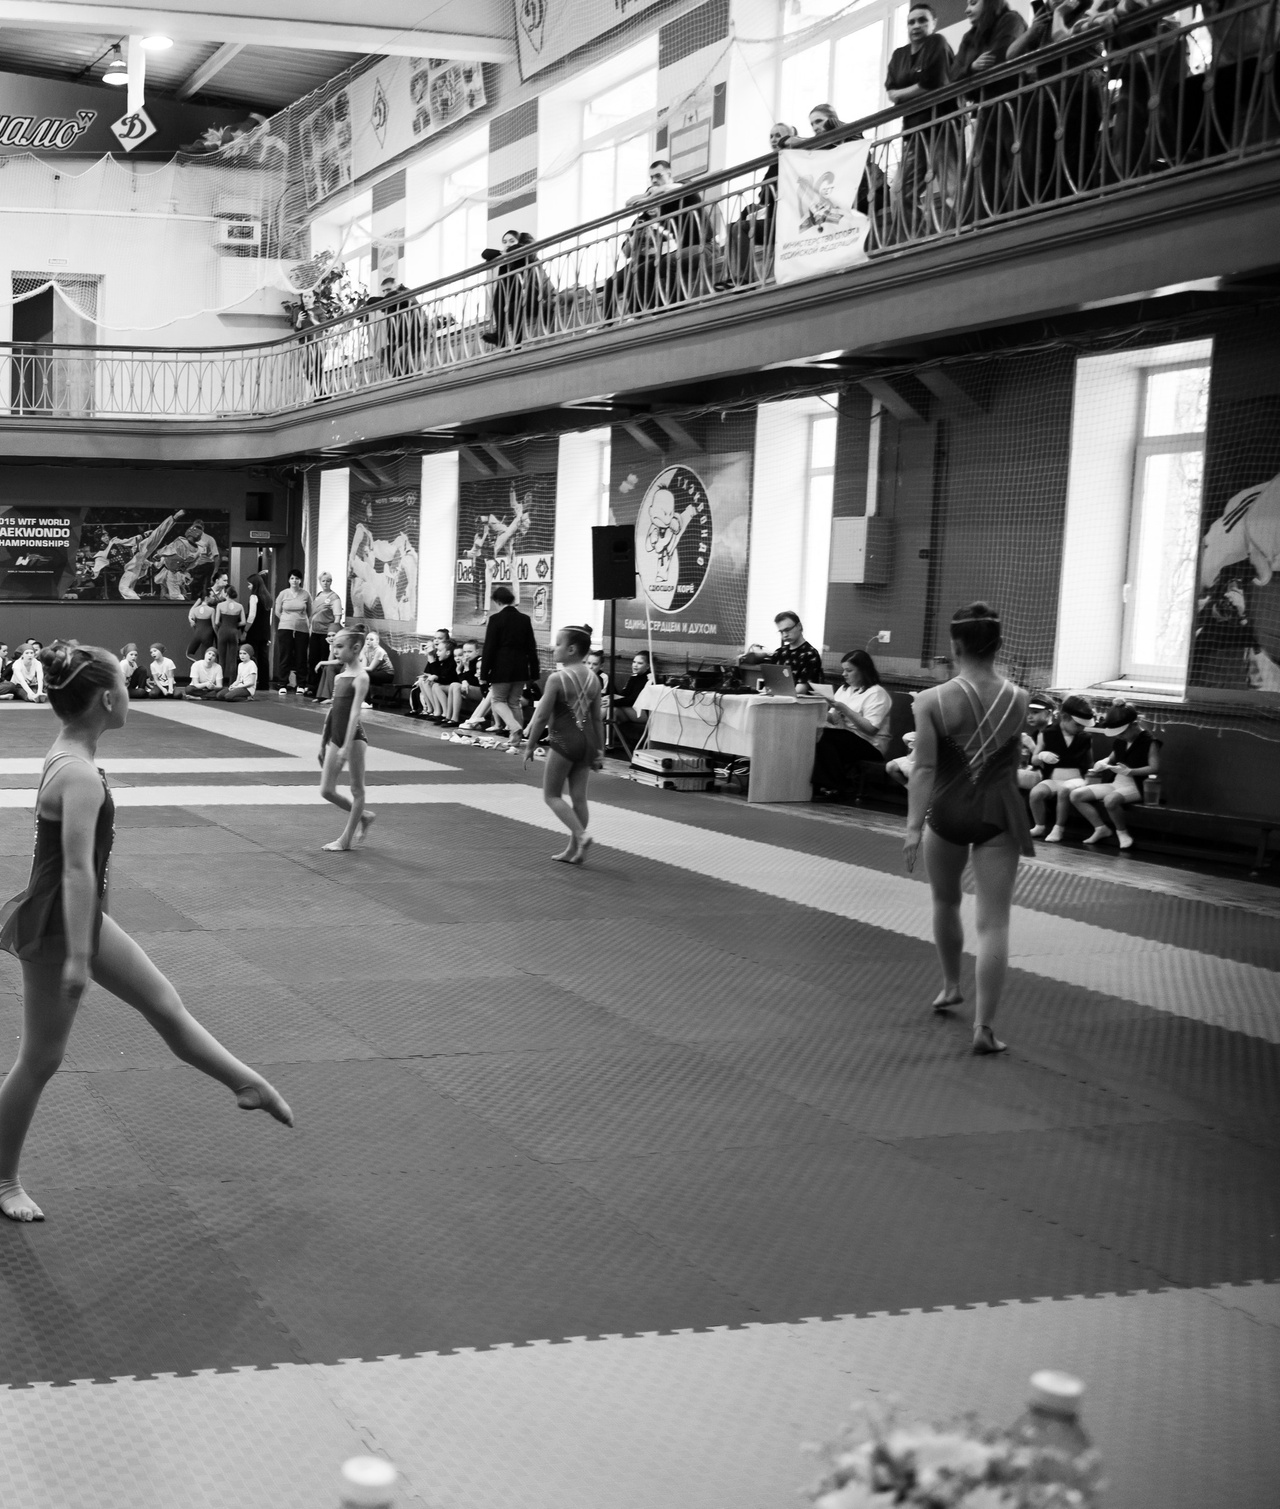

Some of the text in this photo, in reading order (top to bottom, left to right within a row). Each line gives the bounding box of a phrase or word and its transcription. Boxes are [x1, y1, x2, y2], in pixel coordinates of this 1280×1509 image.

[17, 518, 36, 526] WTF
[39, 518, 70, 526] WORLD
[625, 619, 717, 634] ЕДИНЫ СЕРДЦЕМ И ДУХОМ
